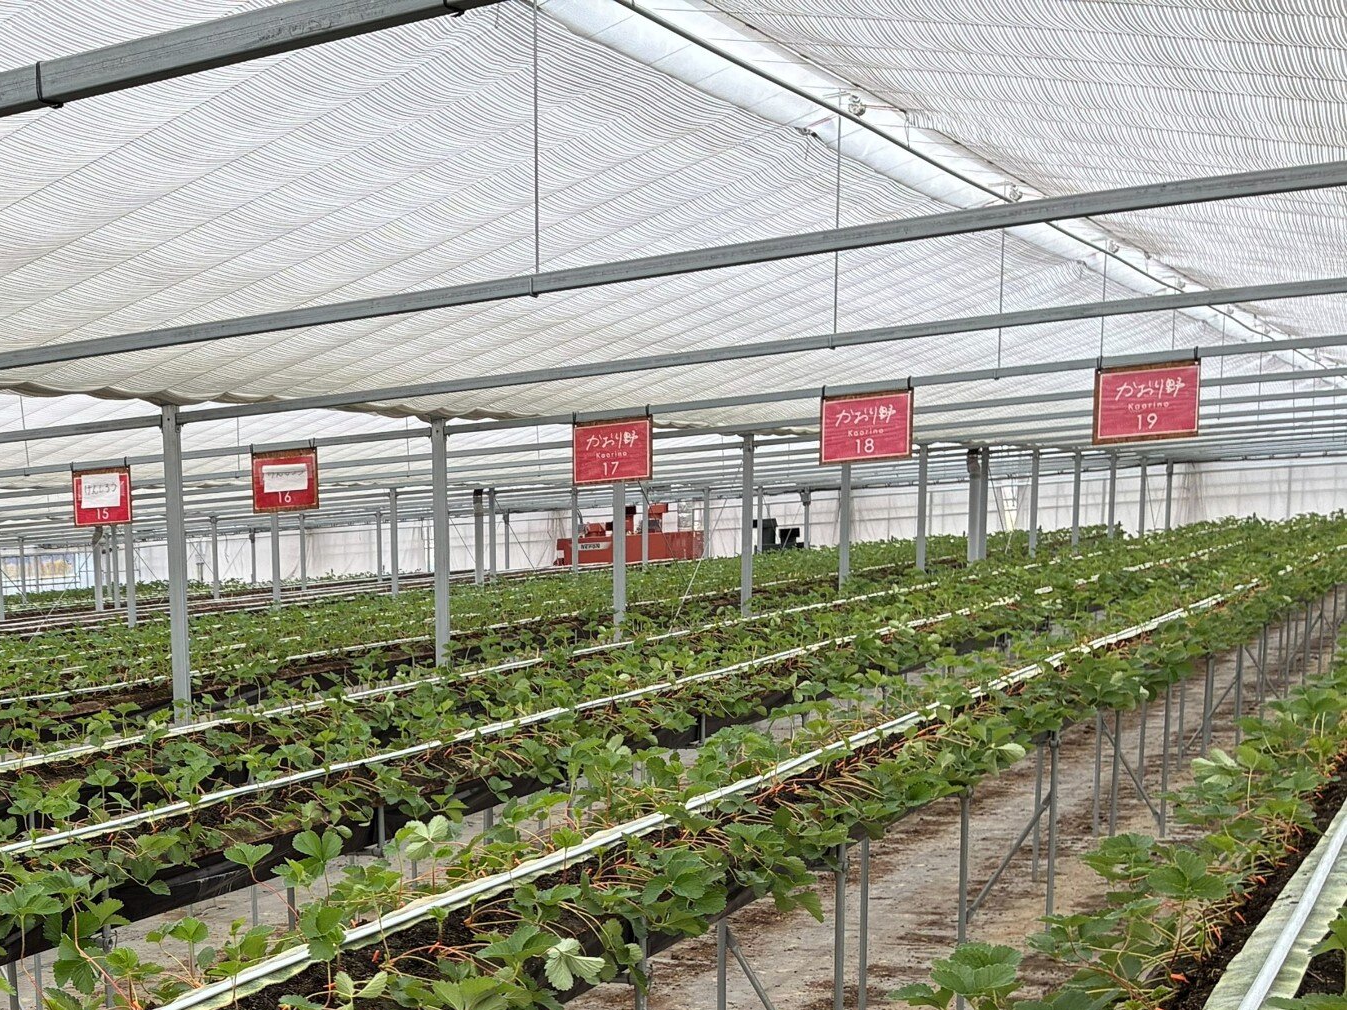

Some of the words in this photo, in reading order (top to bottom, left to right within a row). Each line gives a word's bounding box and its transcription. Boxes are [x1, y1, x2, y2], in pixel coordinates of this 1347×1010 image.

[1114, 376, 1186, 401] かおり野
[1127, 401, 1170, 412] Kaorino
[834, 403, 897, 427] かおり野
[1136, 413, 1158, 431] 19
[847, 428, 884, 437] Kaorino
[855, 438, 875, 454] 18
[595, 450, 628, 459] Kaorino
[602, 461, 620, 476] 17
[278, 491, 292, 503] 16
[96, 507, 109, 520] 15
